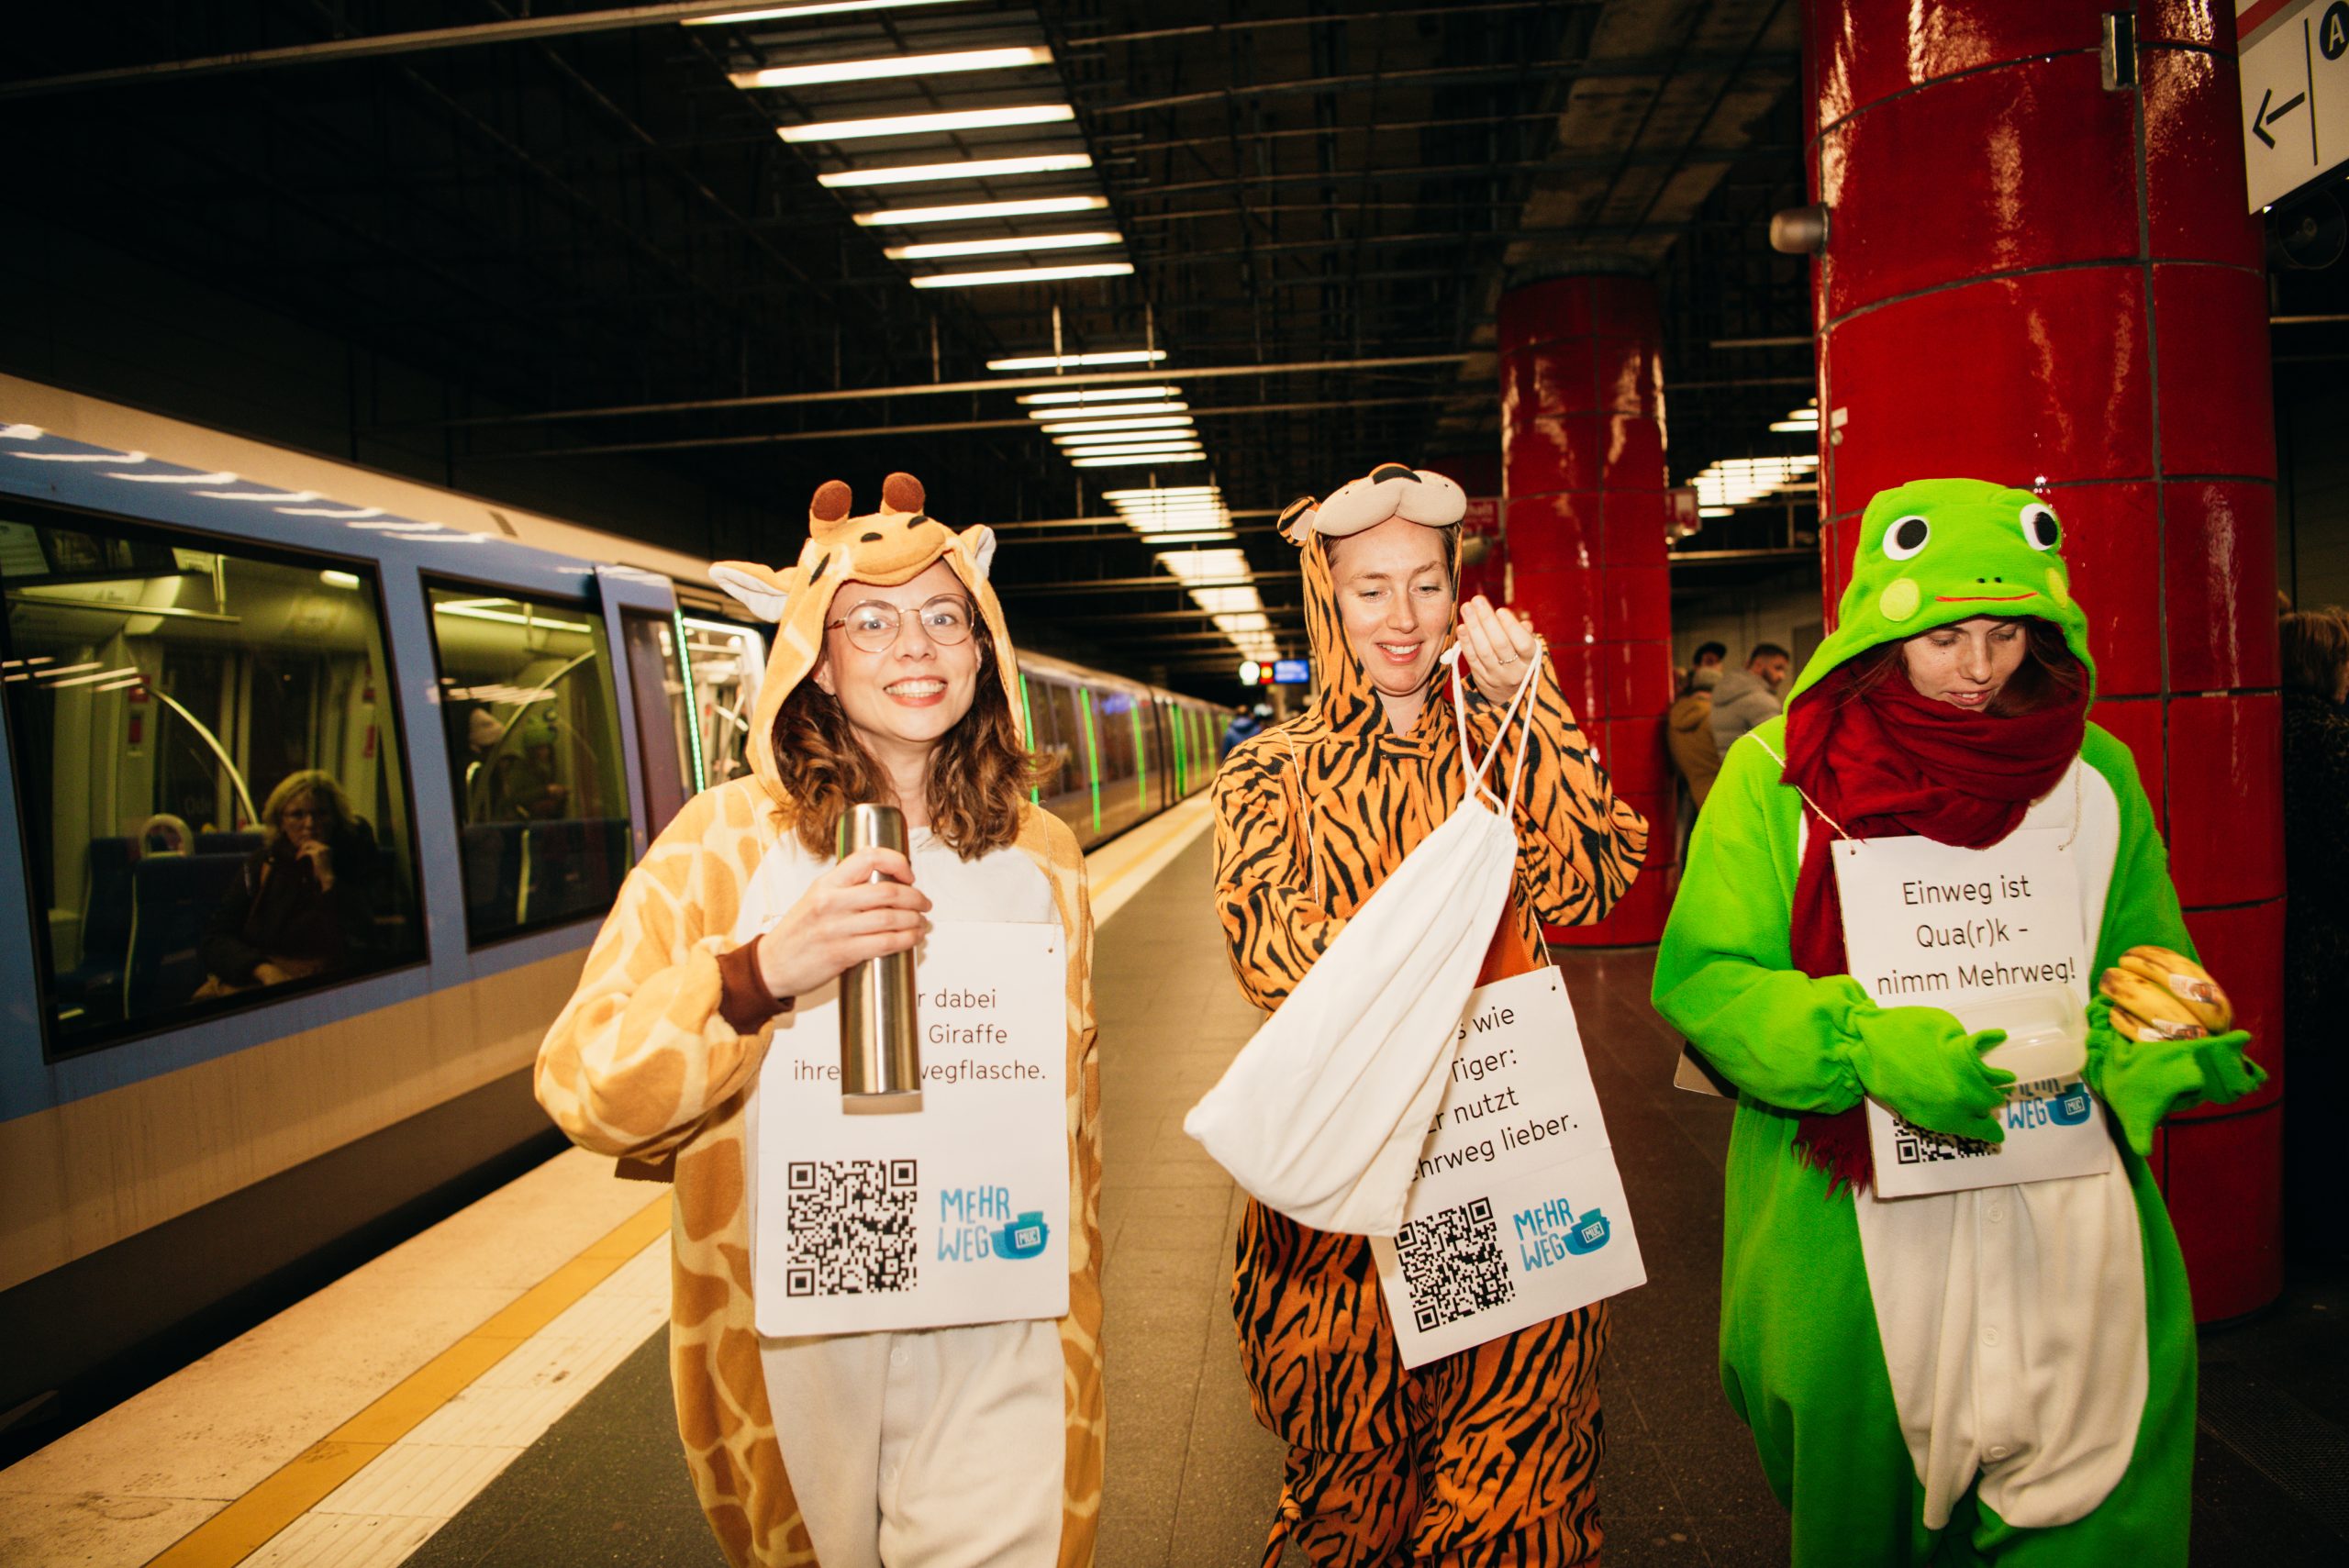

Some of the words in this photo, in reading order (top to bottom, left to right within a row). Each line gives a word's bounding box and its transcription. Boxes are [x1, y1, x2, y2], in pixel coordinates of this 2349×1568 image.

[2328, 13, 2345, 52] A
[1902, 880, 1992, 906] Einweg
[2000, 874, 2032, 898] ist
[1916, 918, 2010, 949] Qua(r)k
[1877, 969, 1949, 995] nimm
[1958, 957, 2076, 988] Mehrweg!
[934, 988, 996, 1008] dabei
[929, 1024, 1008, 1044] Giraffe
[1473, 1006, 1515, 1033] wie
[794, 1059, 841, 1080] ihre
[1452, 1049, 1517, 1083] Tiger:
[1453, 1086, 1520, 1124] nutzt
[2006, 1096, 2047, 1129] WEG
[1411, 1140, 1496, 1183] hrweg
[1500, 1114, 1578, 1151] lieber.
[941, 1184, 1010, 1224] MEHR
[1513, 1197, 1574, 1240] MEHR
[938, 1225, 990, 1262] WEG
[1520, 1232, 1565, 1272] WEG
